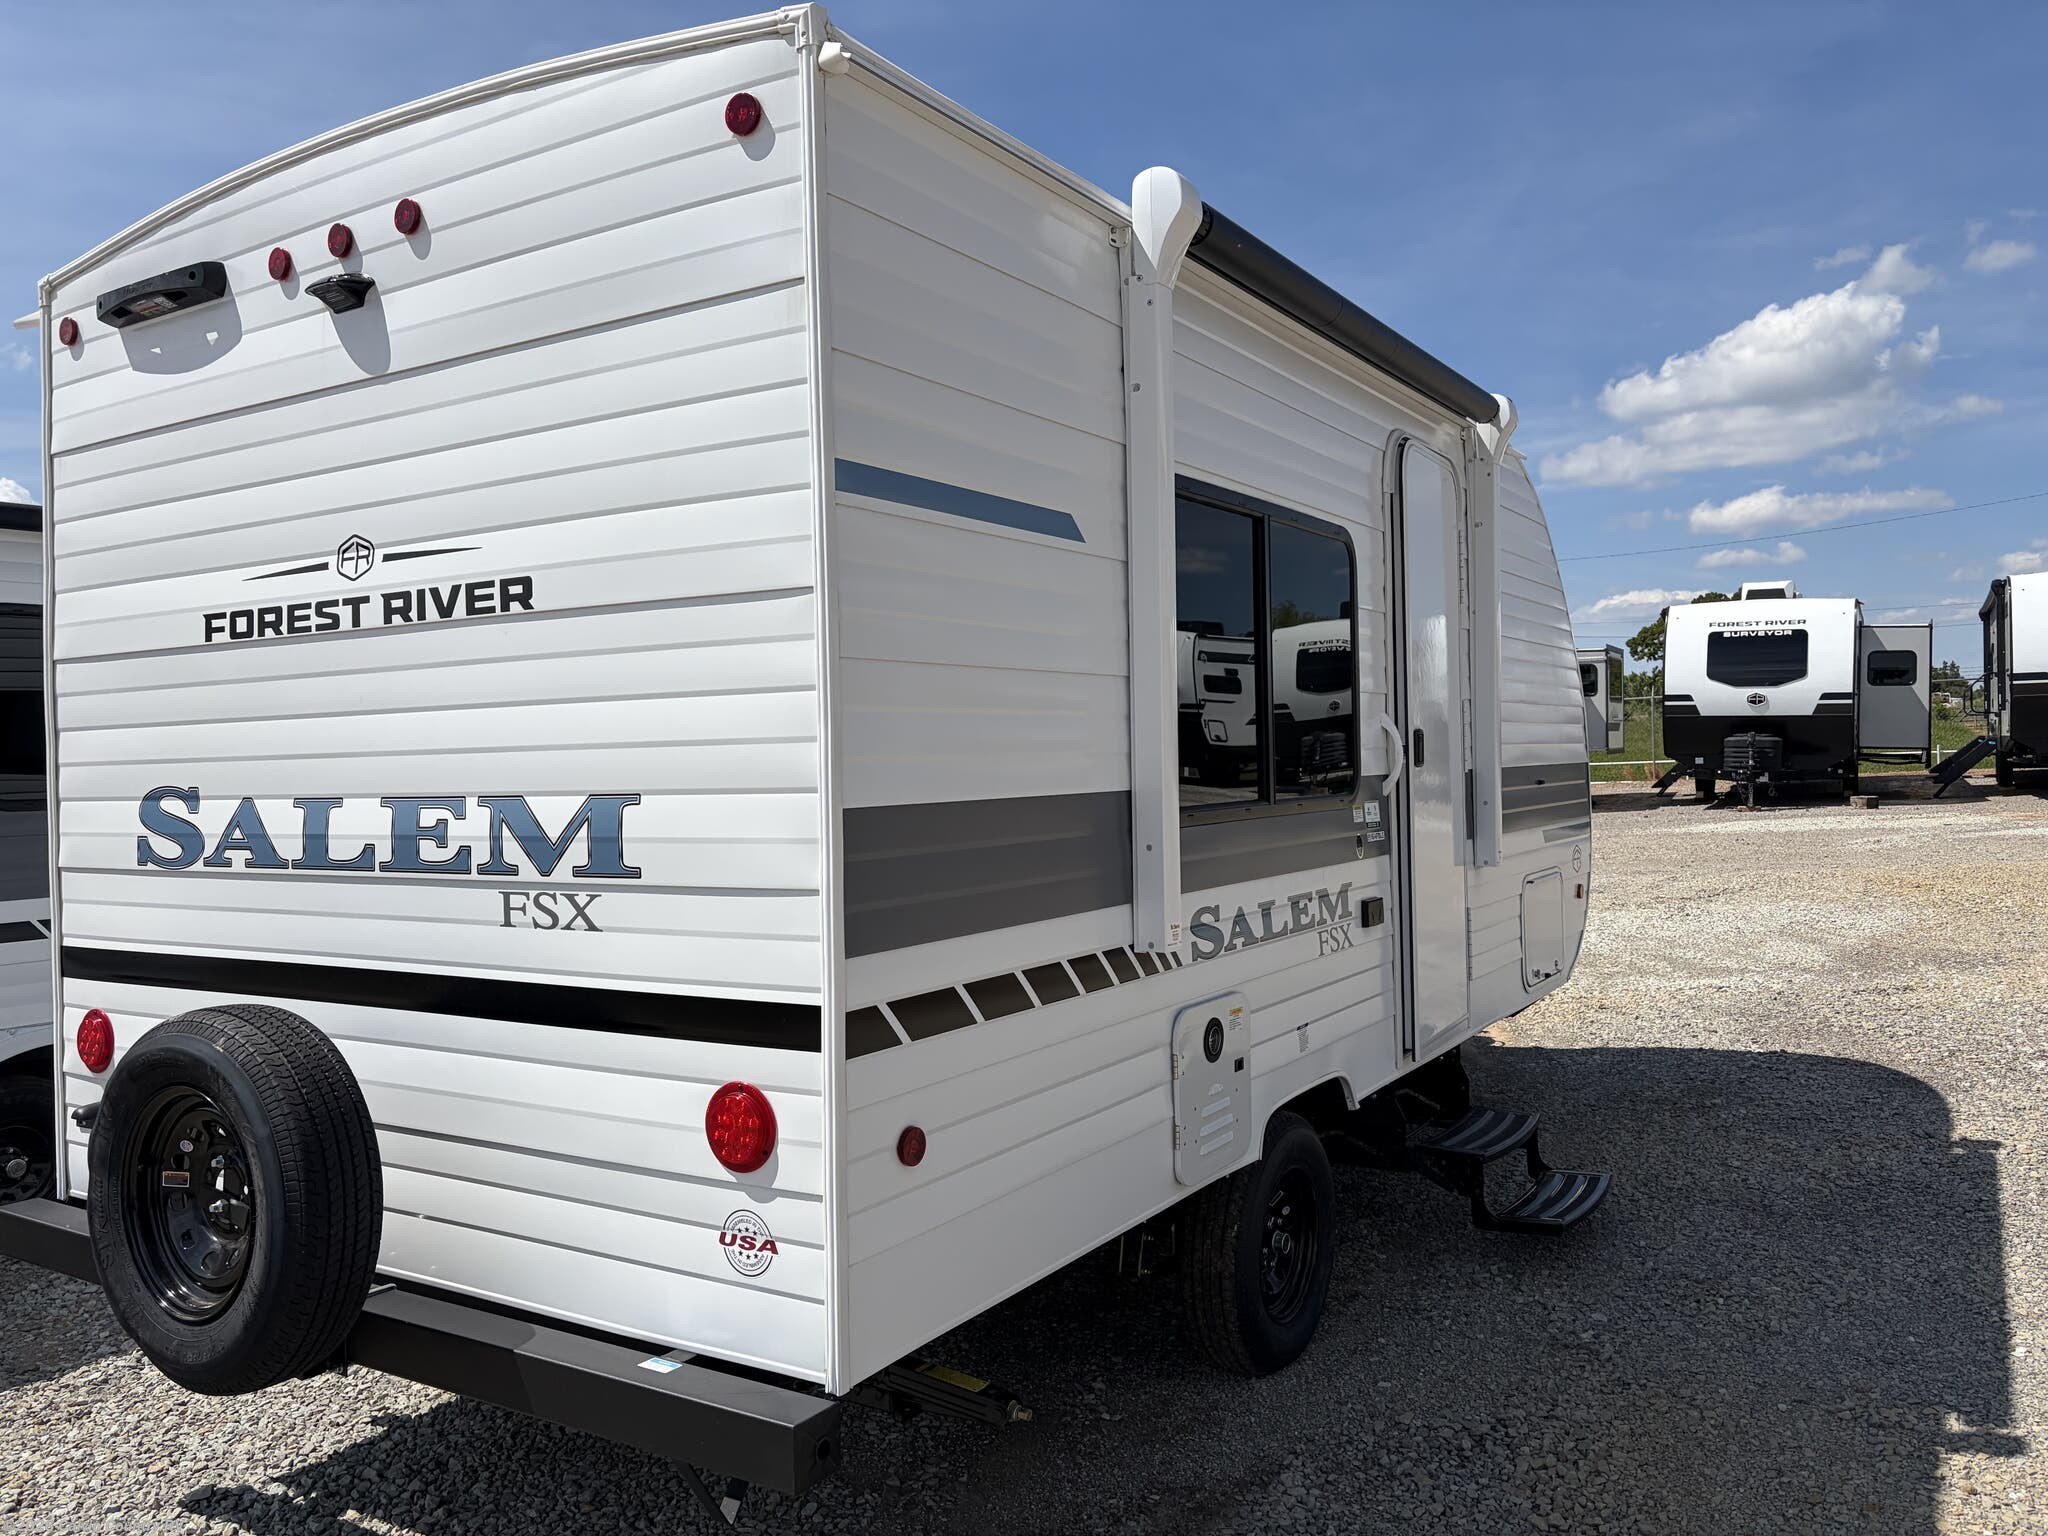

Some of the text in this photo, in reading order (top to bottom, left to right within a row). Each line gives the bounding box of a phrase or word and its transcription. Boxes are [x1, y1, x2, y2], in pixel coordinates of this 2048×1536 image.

[203, 575, 535, 643] FOREST RIVER
[1709, 620, 1762, 628] FOREST
[1723, 629, 1793, 638] SURVEYOR
[137, 785, 641, 879] SALEM
[498, 891, 603, 933] FSX
[1190, 881, 1353, 962] SALEM
[1317, 923, 1354, 957] FSX
[719, 1232, 778, 1255] USA
